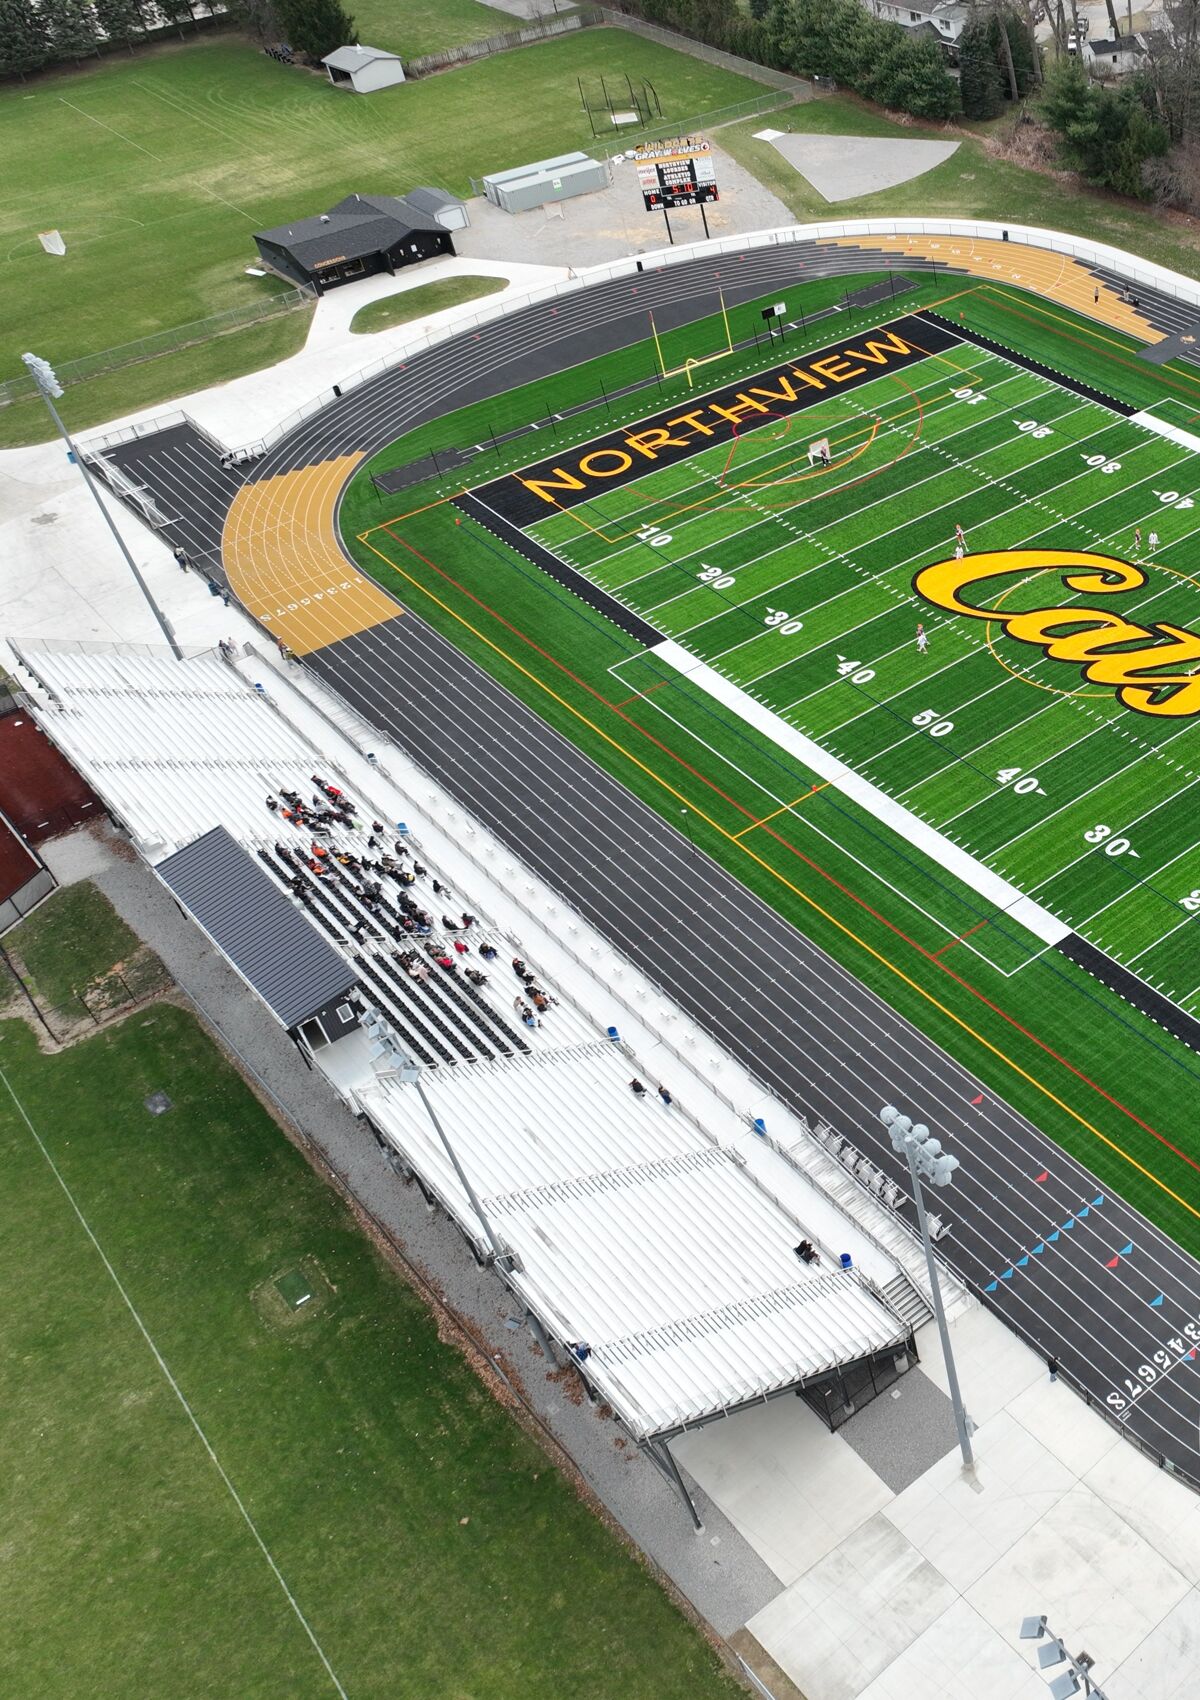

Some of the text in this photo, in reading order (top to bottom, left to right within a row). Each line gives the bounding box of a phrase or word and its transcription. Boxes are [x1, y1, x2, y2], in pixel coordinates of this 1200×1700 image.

[664, 172, 691, 180] ATHLETIC
[665, 177, 691, 186] COMPLEX
[672, 182, 694, 194] 5:10
[954, 388, 987, 405] 10
[523, 333, 912, 502] NORTHVIEW
[1018, 420, 1054, 439] 20
[1086, 454, 1122, 474] 30
[1158, 491, 1195, 510] 40
[636, 525, 673, 547] 10
[340, 582, 352, 590] 2
[696, 566, 736, 590] 20
[326, 587, 338, 595] 3
[288, 603, 298, 611] 6
[300, 598, 311, 606] 5
[276, 608, 286, 617] 7
[764, 610, 804, 636] 30
[836, 660, 876, 685] 40
[911, 708, 955, 737] 50
[996, 767, 1039, 795] 40
[1084, 824, 1130, 857] 30
[1166, 1338, 1186, 1354] 4
[1154, 1350, 1172, 1369] 5
[1138, 1364, 1156, 1382] 6
[1124, 1379, 1142, 1398] 7
[1106, 1392, 1126, 1410] 8
